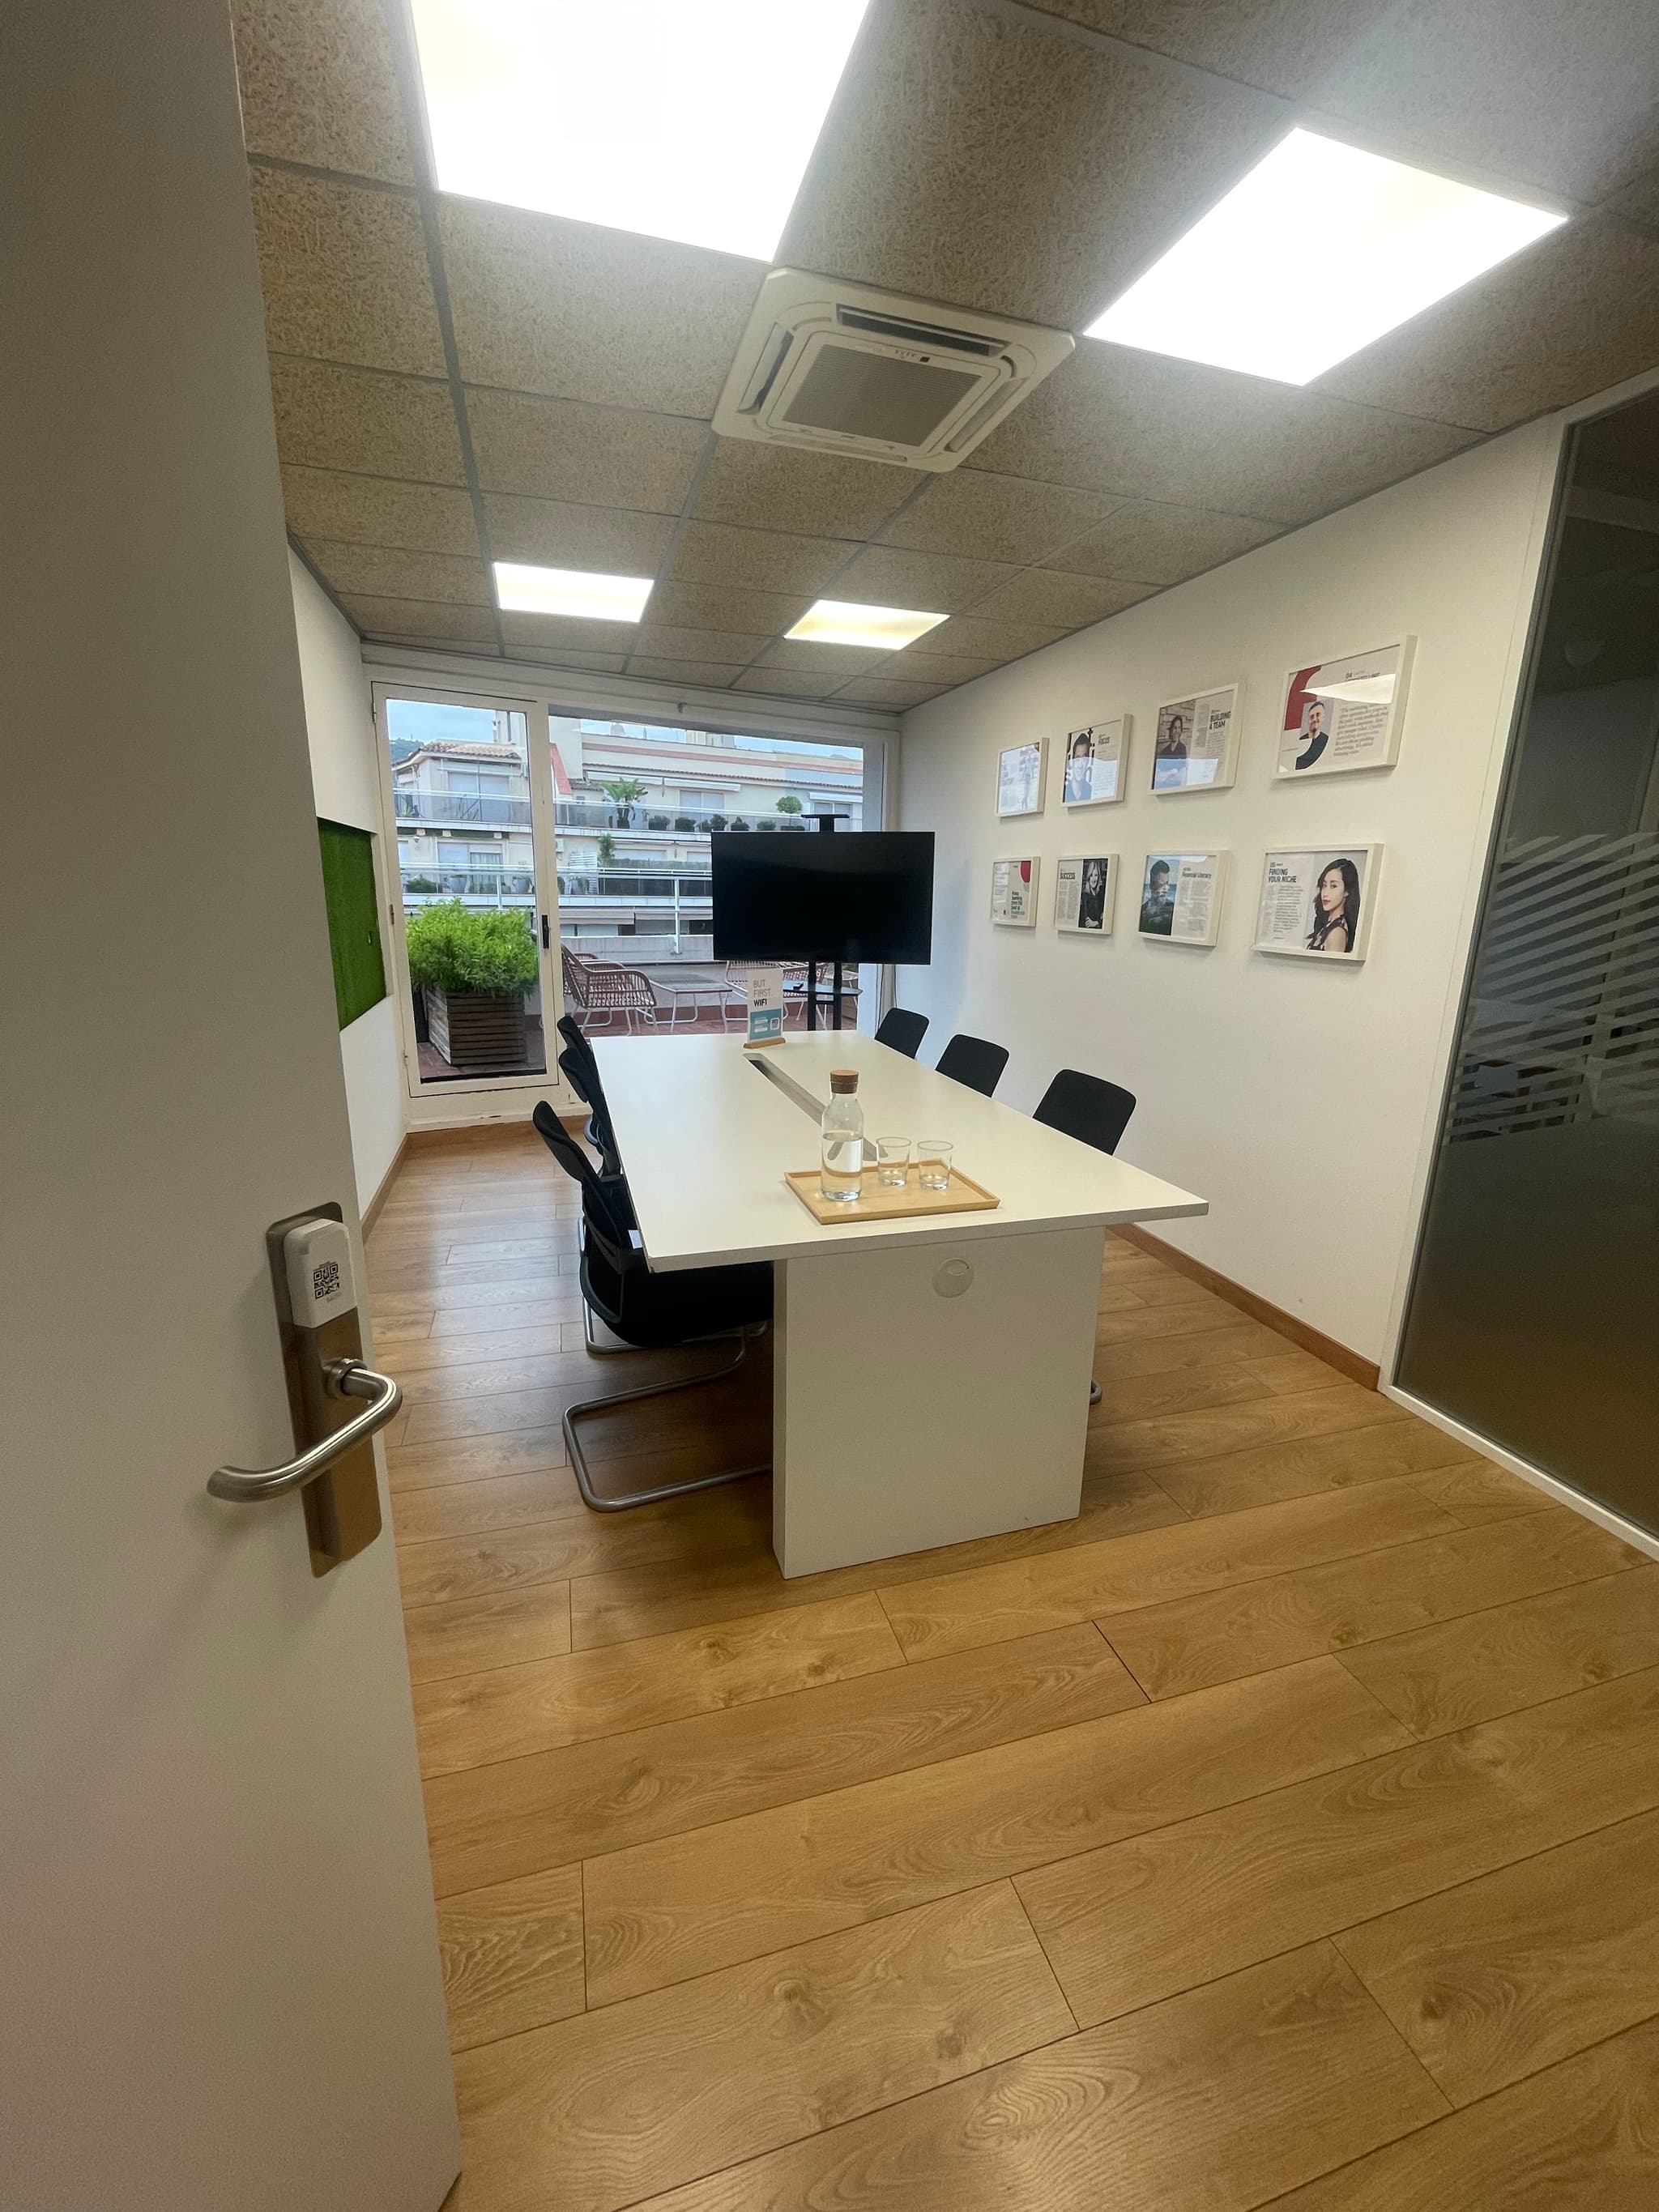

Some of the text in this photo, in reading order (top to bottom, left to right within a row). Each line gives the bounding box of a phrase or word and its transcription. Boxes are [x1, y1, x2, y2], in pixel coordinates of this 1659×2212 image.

[1213, 720, 1226, 729] TEAM
[753, 979, 766, 988] BUT
[753, 998, 767, 1007] WIFI
